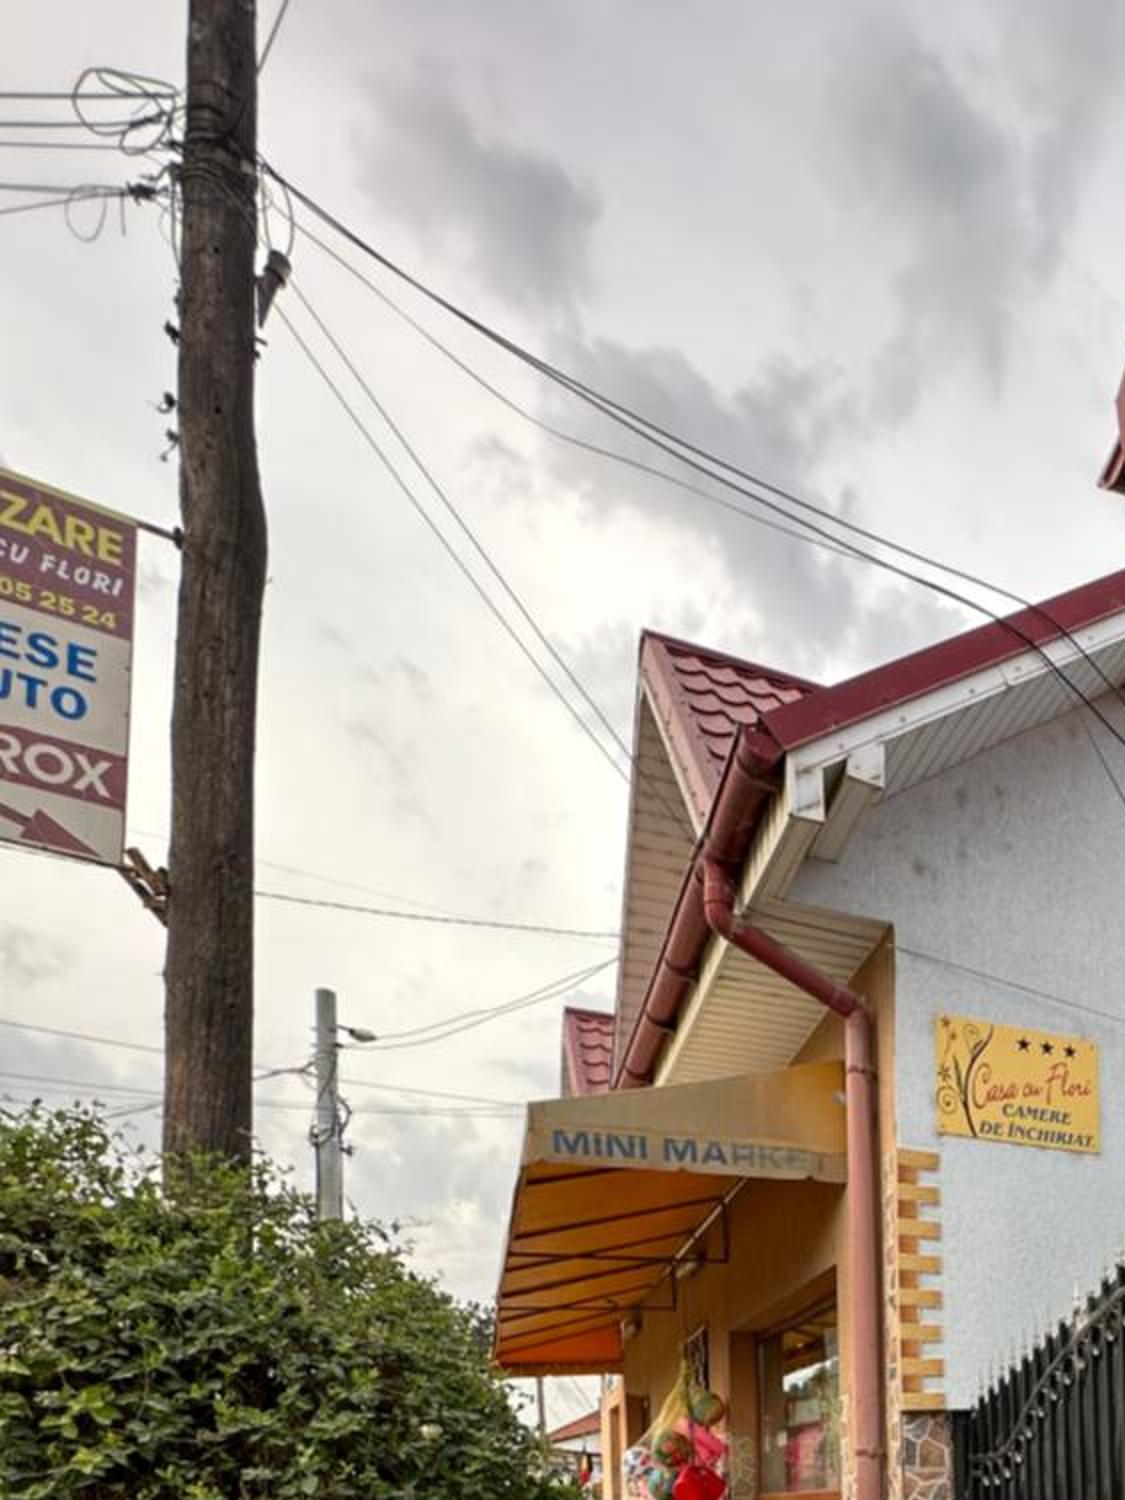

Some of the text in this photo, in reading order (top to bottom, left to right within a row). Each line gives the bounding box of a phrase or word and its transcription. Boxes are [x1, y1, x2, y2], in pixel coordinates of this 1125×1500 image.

[40, 554, 123, 596] FLORI
[39, 591, 75, 616] 25
[82, 605, 117, 630] 24
[972, 1062, 1018, 1109] Casa
[1046, 1062, 1091, 1105] Flori
[979, 1120, 1002, 1136] DE
[1002, 1103, 1071, 1125] CAMERE
[551, 1129, 827, 1174] MINI MARKET
